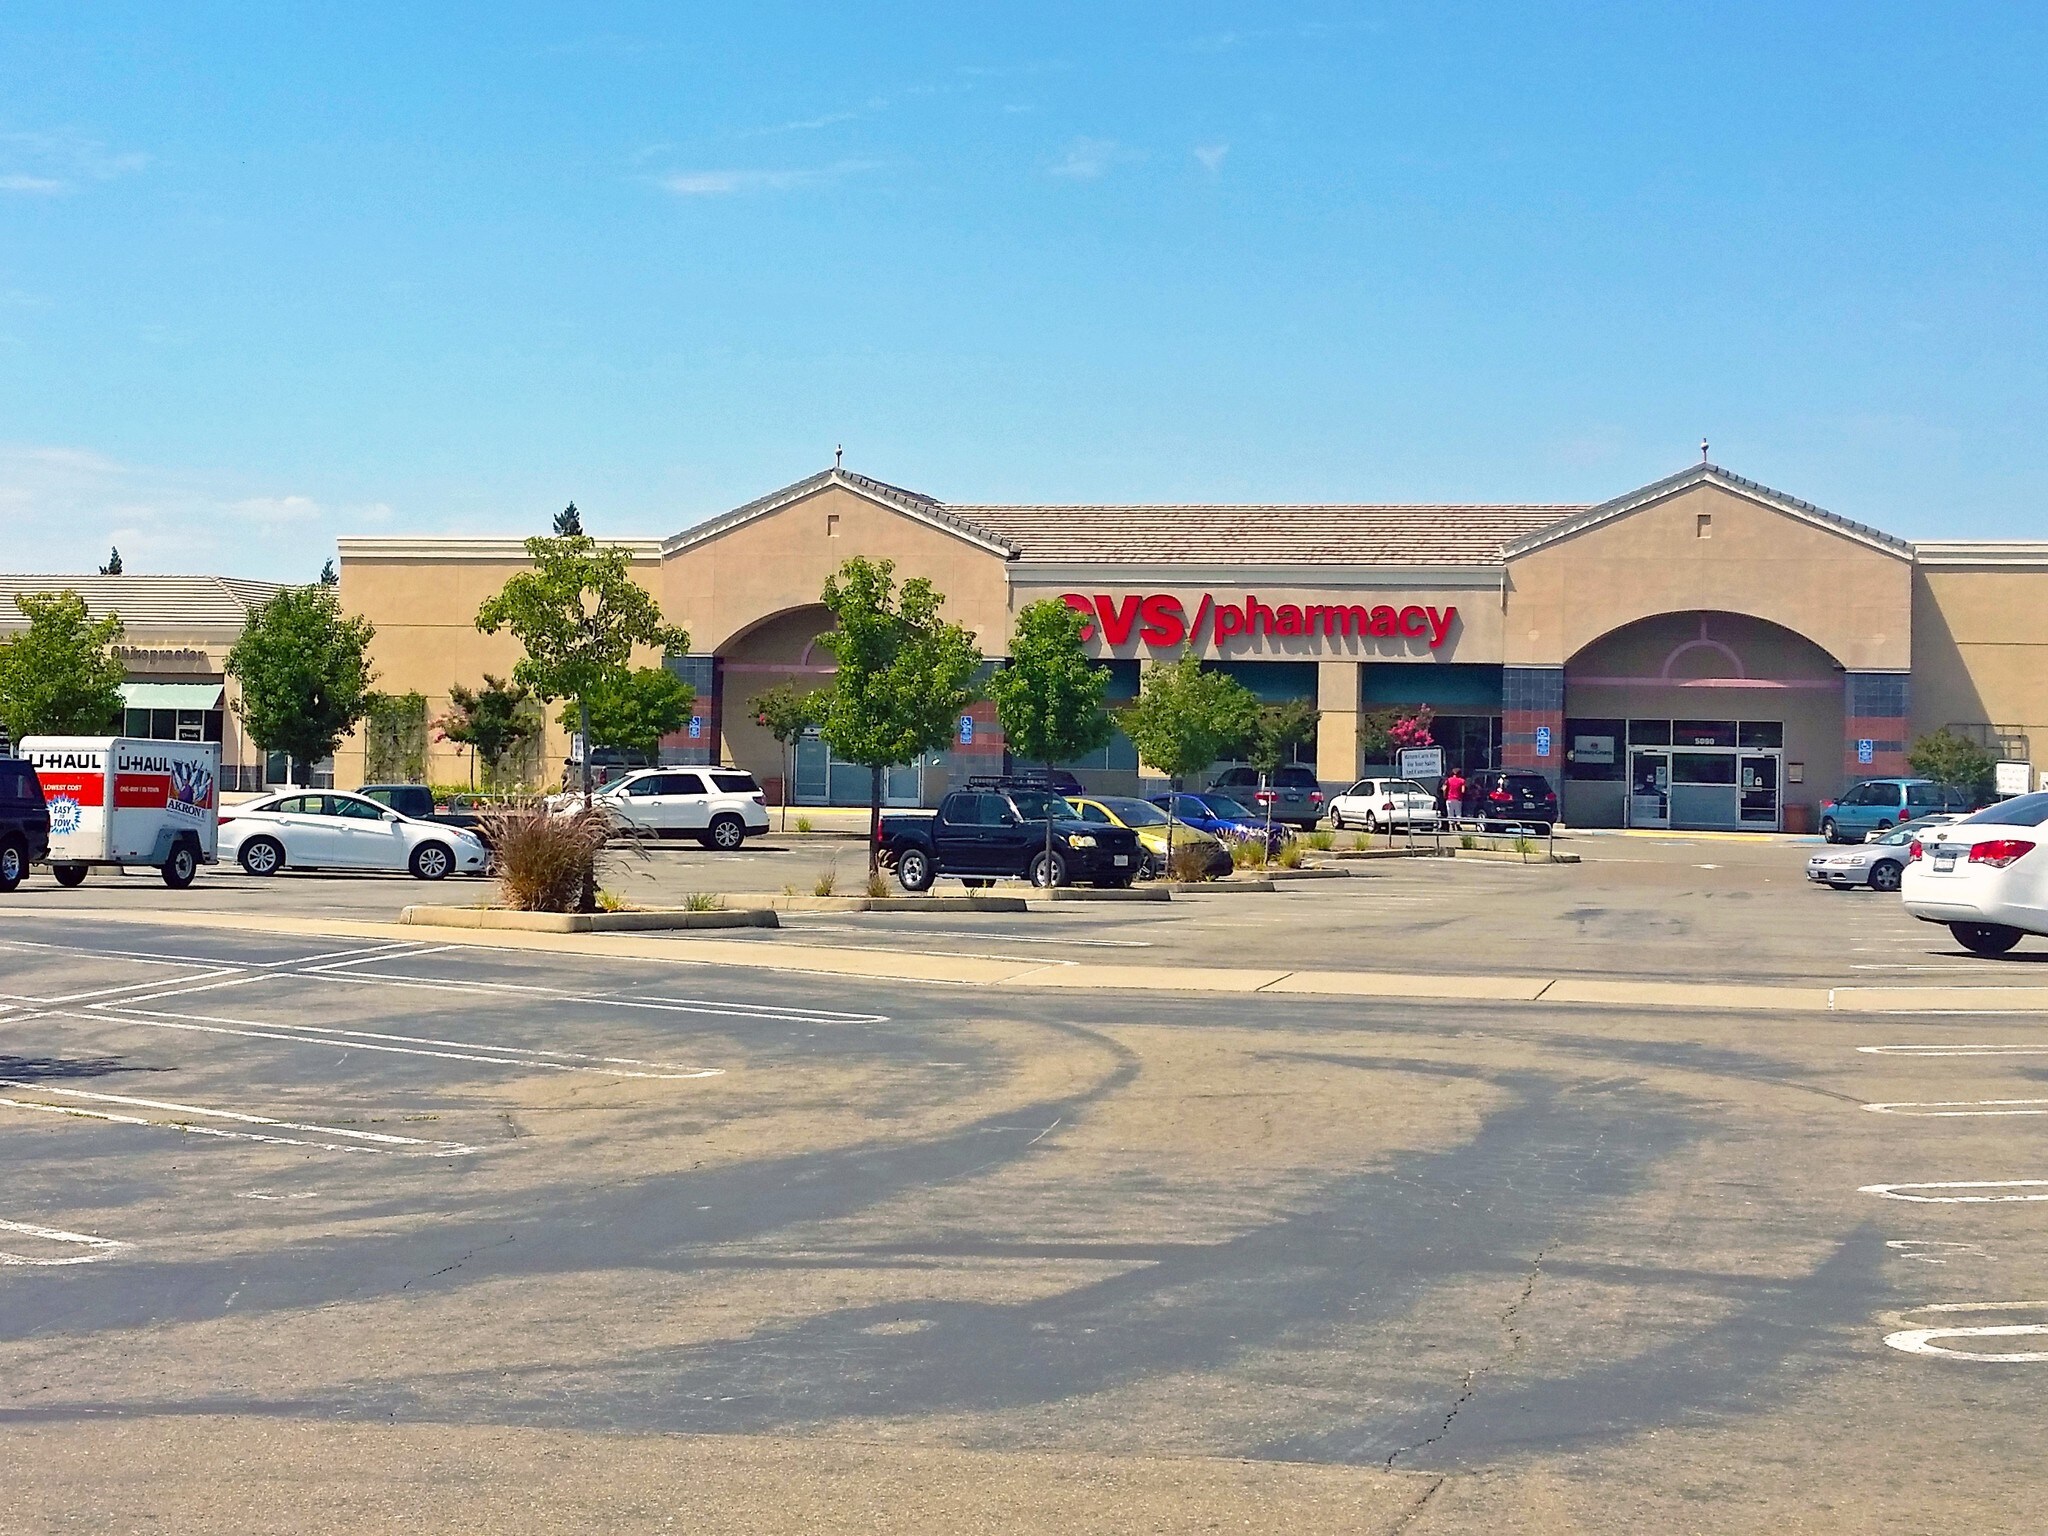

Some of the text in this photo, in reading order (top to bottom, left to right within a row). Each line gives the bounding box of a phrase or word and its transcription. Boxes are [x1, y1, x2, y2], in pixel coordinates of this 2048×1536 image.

[111, 646, 206, 664] Chiropractor
[29, 754, 101, 769] U-HAUL
[118, 756, 170, 771] U-HAUL
[54, 806, 72, 814] EASY
[168, 800, 201, 817] AKRON
[54, 819, 71, 827] TOW
